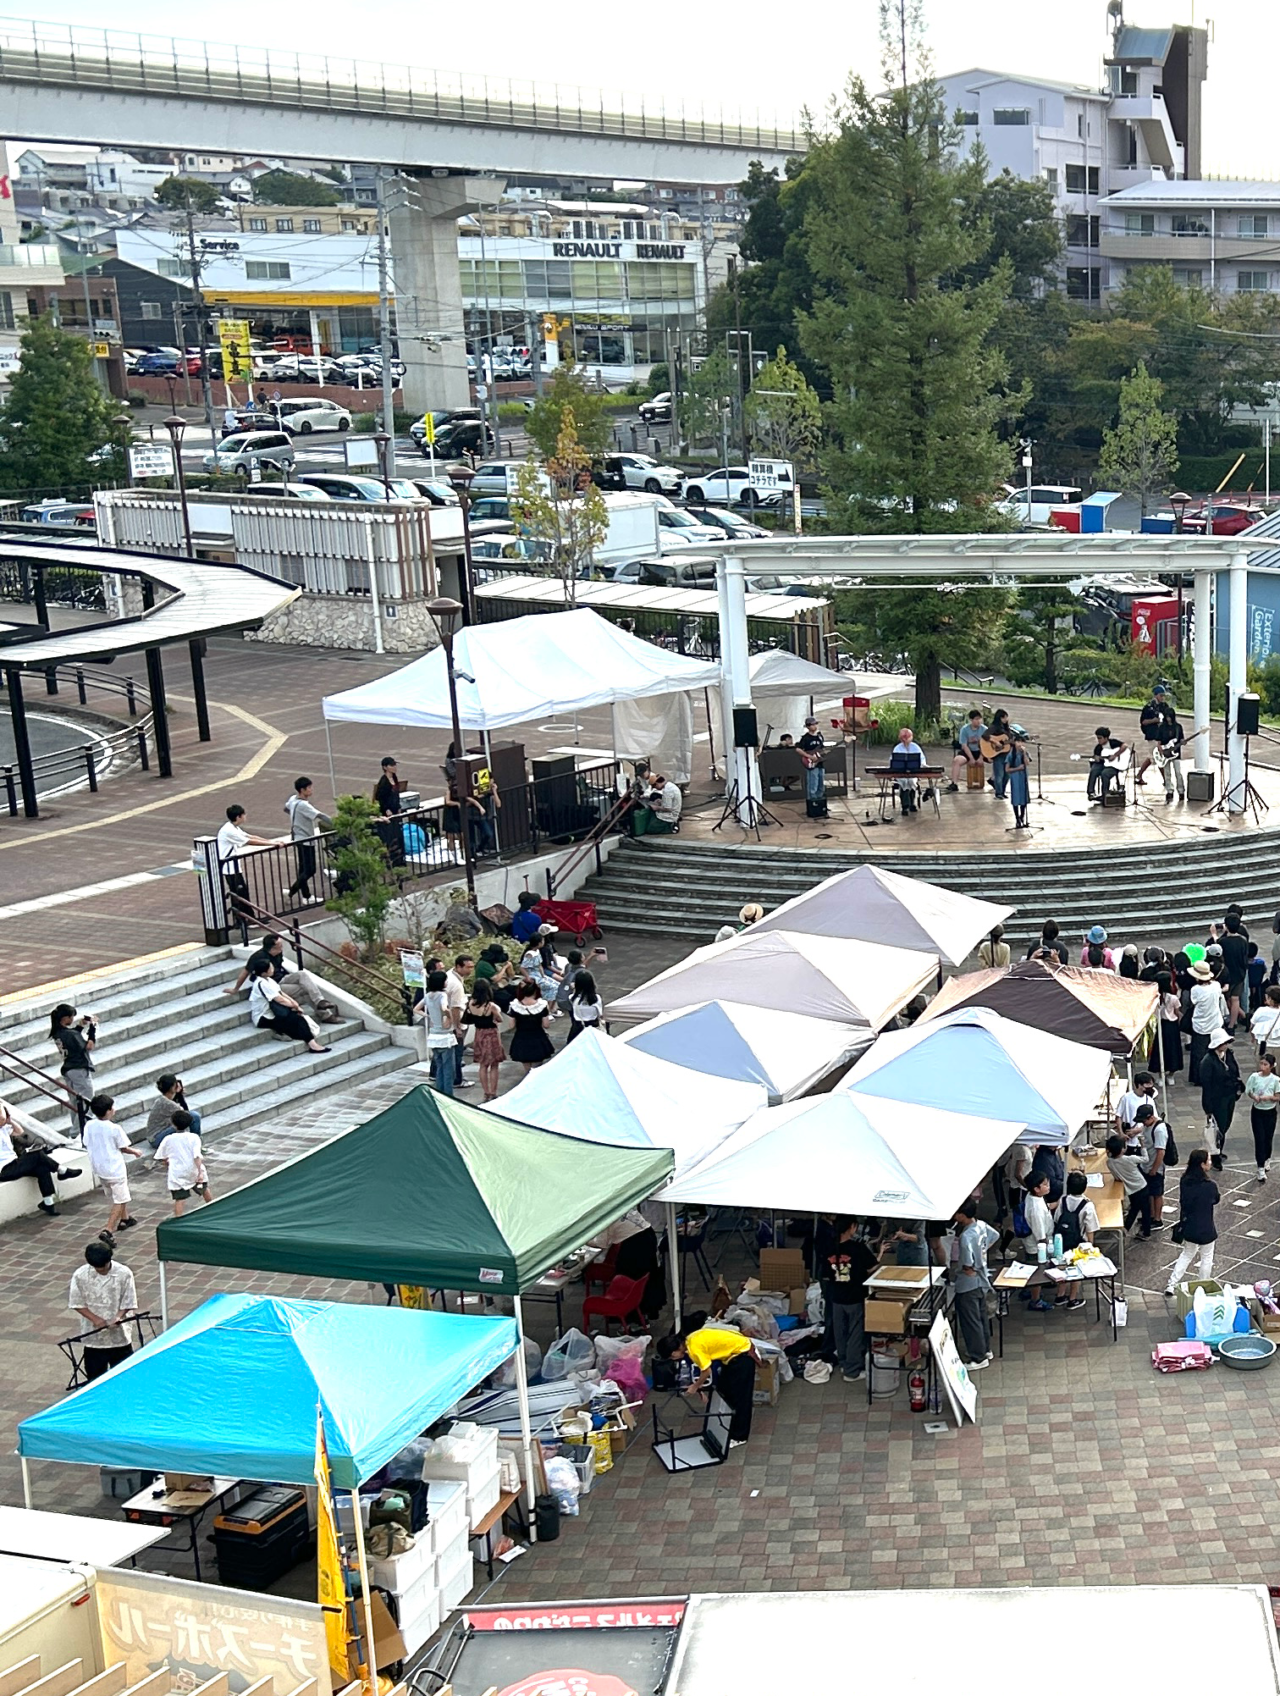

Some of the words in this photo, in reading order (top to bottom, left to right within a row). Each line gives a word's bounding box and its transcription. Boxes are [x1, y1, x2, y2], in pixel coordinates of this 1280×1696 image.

[200, 238, 240, 251] Service
[553, 242, 622, 258] RENAULT
[636, 243, 686, 259] RENAULT
[750, 475, 777, 487] コチラです
[1254, 610, 1264, 654] Garden
